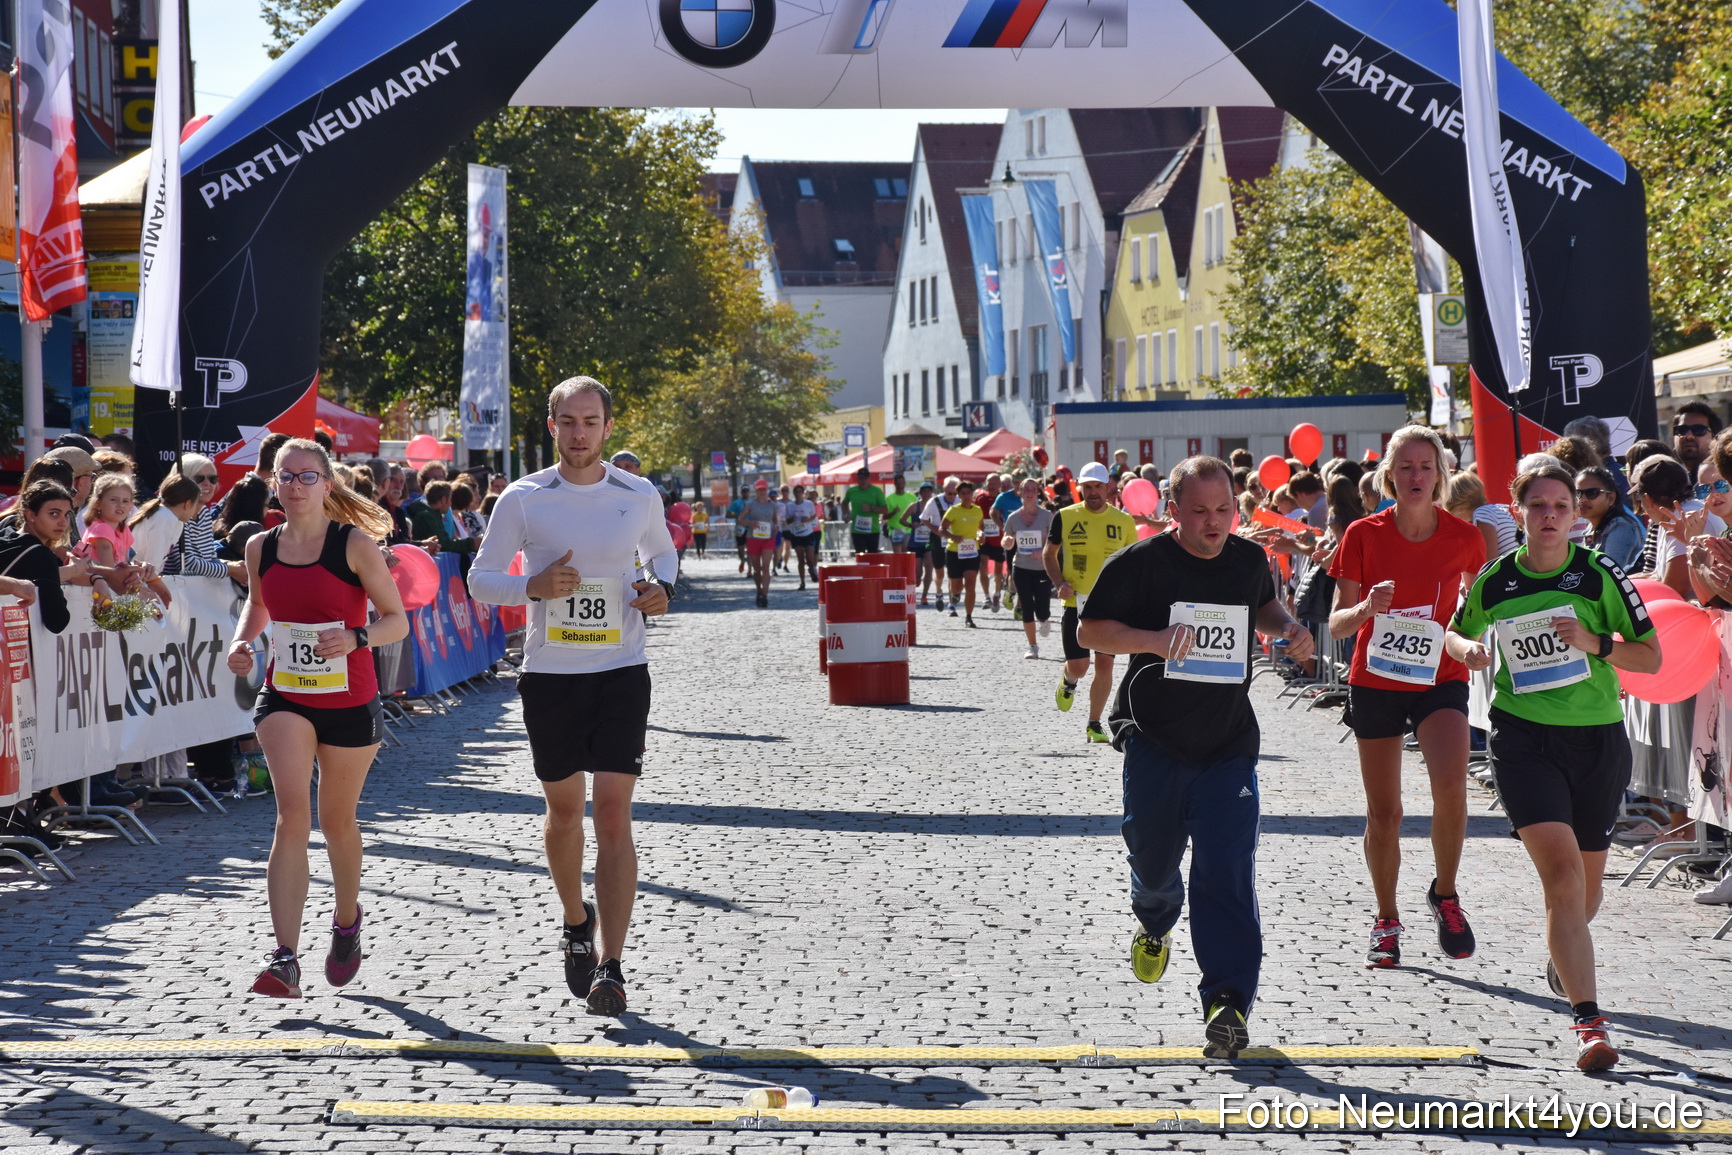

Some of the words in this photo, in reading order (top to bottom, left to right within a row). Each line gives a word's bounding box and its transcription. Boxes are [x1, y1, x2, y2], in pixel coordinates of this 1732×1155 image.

[199, 143, 300, 209] PARTL
[297, 41, 463, 153] NEUMARKT
[1322, 43, 1415, 115] PARTL
[1420, 97, 1592, 202] NEARKT
[92, 402, 112, 418] 19.
[200, 441, 231, 453] NEXT
[158, 451, 176, 462] 100
[1020, 537, 1038, 545] 2101
[573, 584, 604, 593] OCK
[565, 597, 607, 621] 138
[1194, 610, 1227, 621] BOCK
[1394, 620, 1427, 633] BOCK
[1515, 616, 1552, 633] BOCK
[291, 628, 320, 639] BOCK
[561, 630, 607, 642] Sebastian
[1186, 624, 1236, 651] 023
[1379, 632, 1433, 657] 2435
[1511, 632, 1571, 661] 3003
[1397, 655, 1419, 663] Neumarkt
[1539, 657, 1562, 666] Neumarkt
[1390, 663, 1412, 675] Julia
[54, 630, 123, 734] PARTL
[297, 677, 318, 687] Tina
